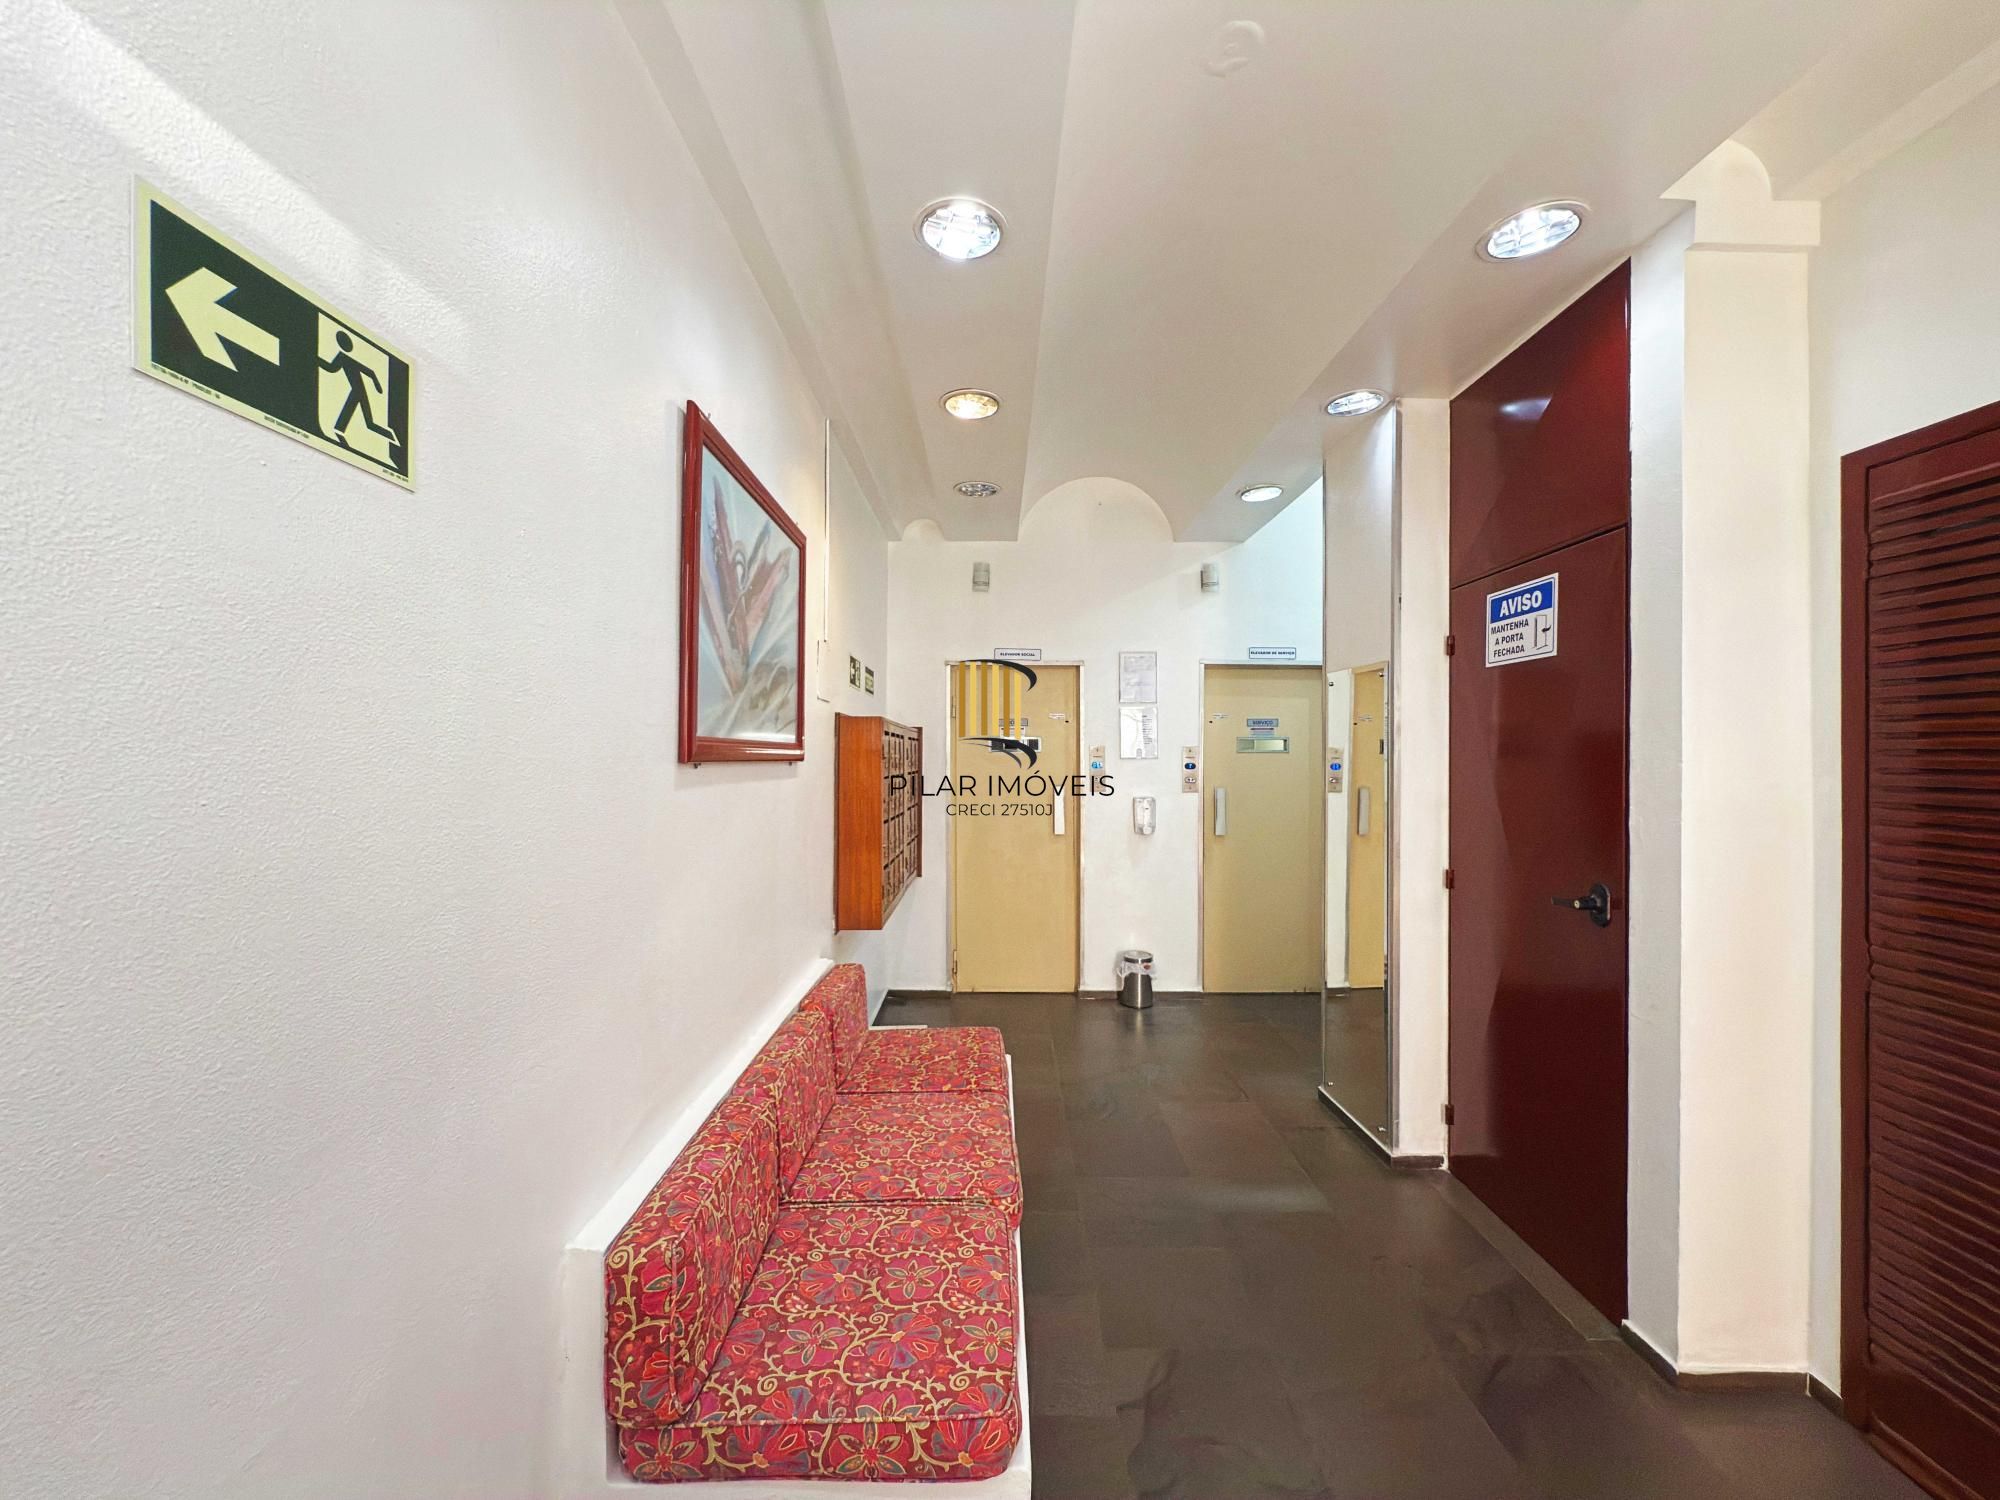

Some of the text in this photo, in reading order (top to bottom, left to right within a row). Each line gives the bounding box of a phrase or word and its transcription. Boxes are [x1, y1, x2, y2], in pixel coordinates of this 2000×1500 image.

[1500, 590, 1542, 617] AVISO
[1491, 618, 1529, 635] MANTENHA
[1495, 632, 1524, 646] A PORTA
[1493, 645, 1525, 658] FECHADA
